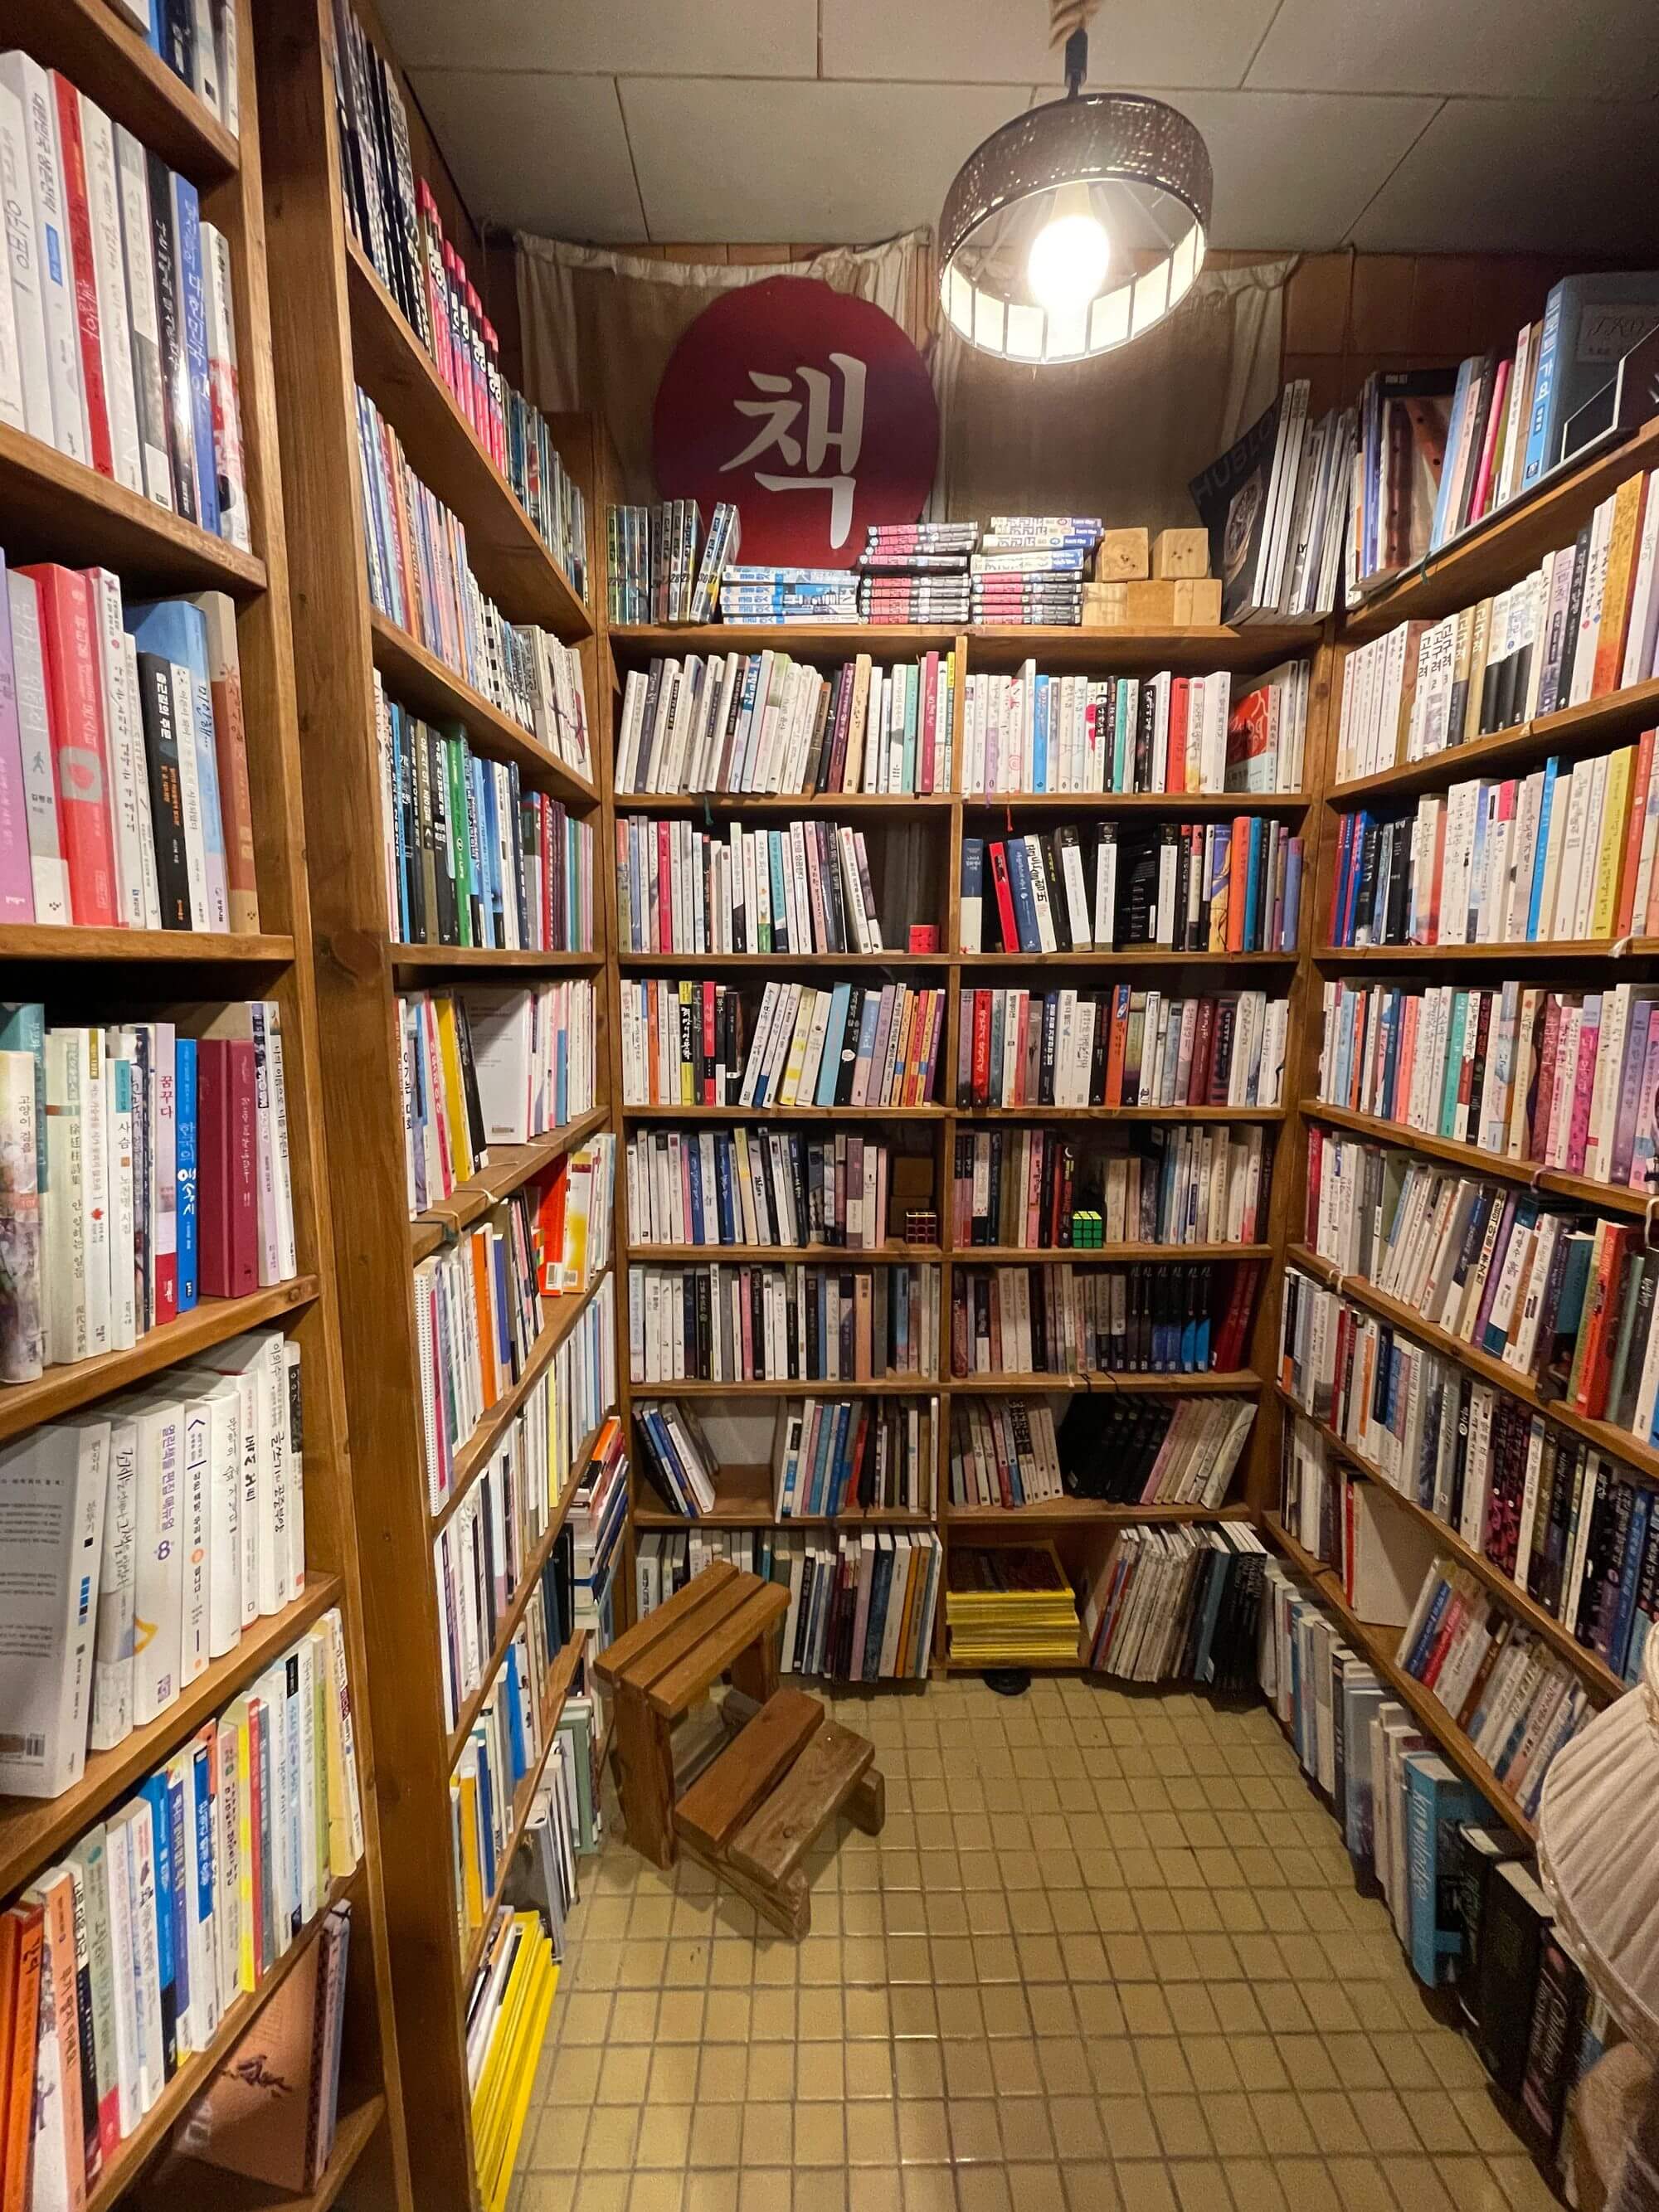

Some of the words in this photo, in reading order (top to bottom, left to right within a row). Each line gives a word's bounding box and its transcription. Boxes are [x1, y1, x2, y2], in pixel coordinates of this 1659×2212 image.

[32, 93, 54, 151] 대한민국
[719, 352, 867, 549] 책
[1418, 636, 1432, 679] 고구려
[1431, 631, 1443, 673] 고구려
[1443, 625, 1453, 667] 고구려
[159, 1075, 173, 1121] 꿈꾸다
[118, 1122, 131, 1151] 사슴
[270, 1341, 283, 1377] 이외수
[161, 1423, 177, 1469] 열린책들
[161, 1471, 176, 1495] 편집
[160, 1496, 176, 1531] 매뉴얼
[272, 1485, 286, 1534] 공중부양
